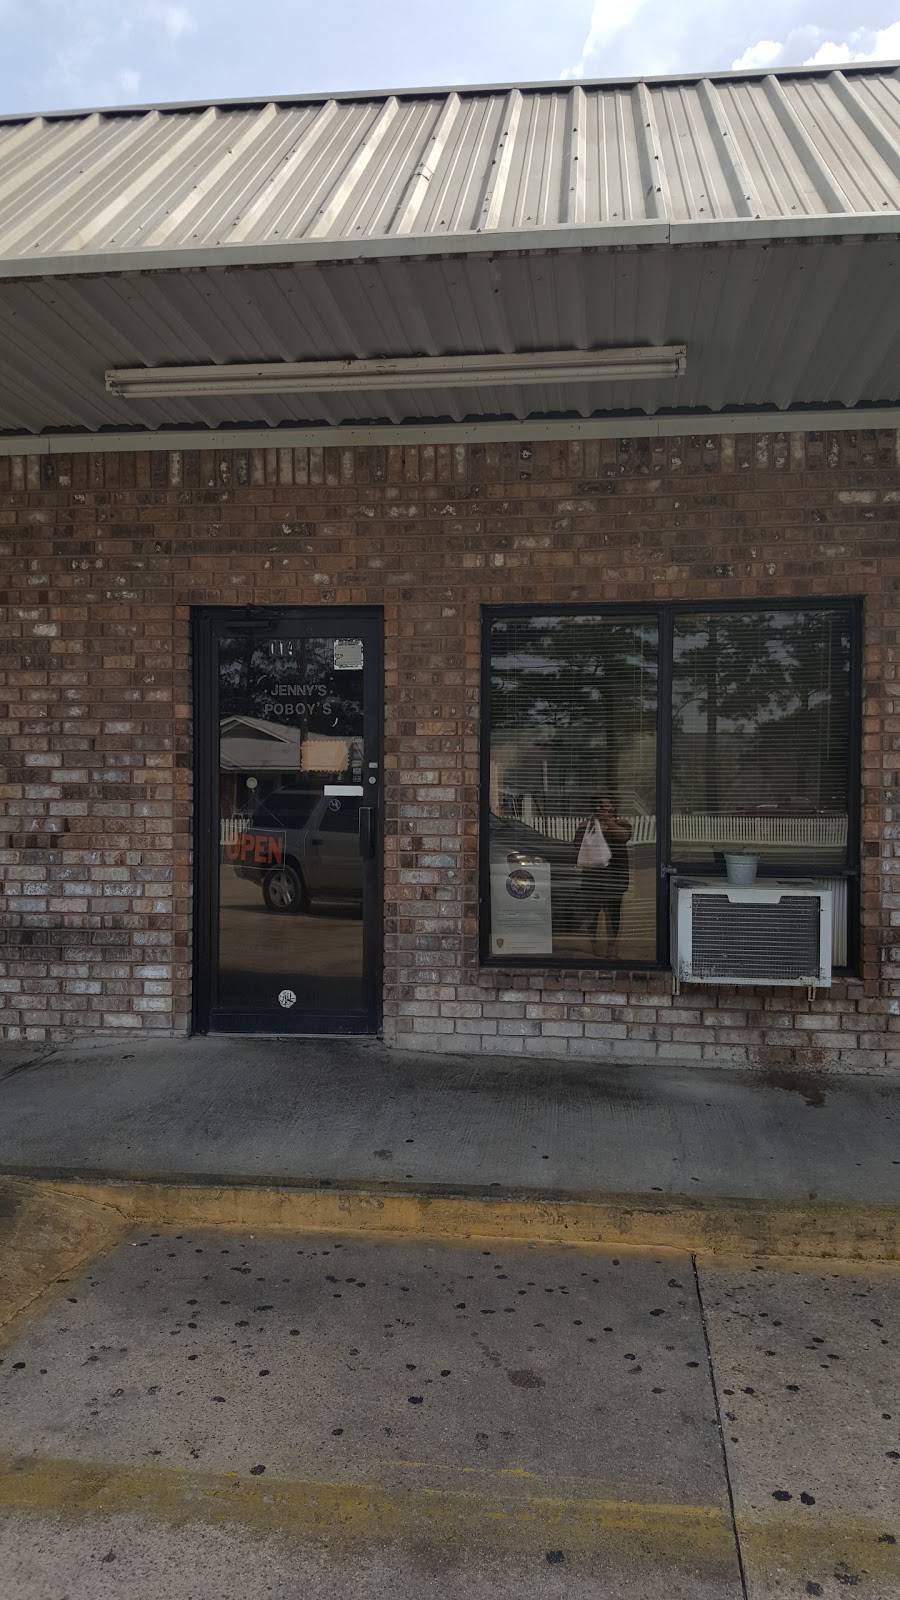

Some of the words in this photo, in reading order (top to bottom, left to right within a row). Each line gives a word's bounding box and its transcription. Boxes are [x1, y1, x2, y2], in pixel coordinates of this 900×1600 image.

[270, 684, 327, 697] JENNY'S
[264, 702, 332, 715] POBOY'S
[225, 833, 282, 864] OPEN
